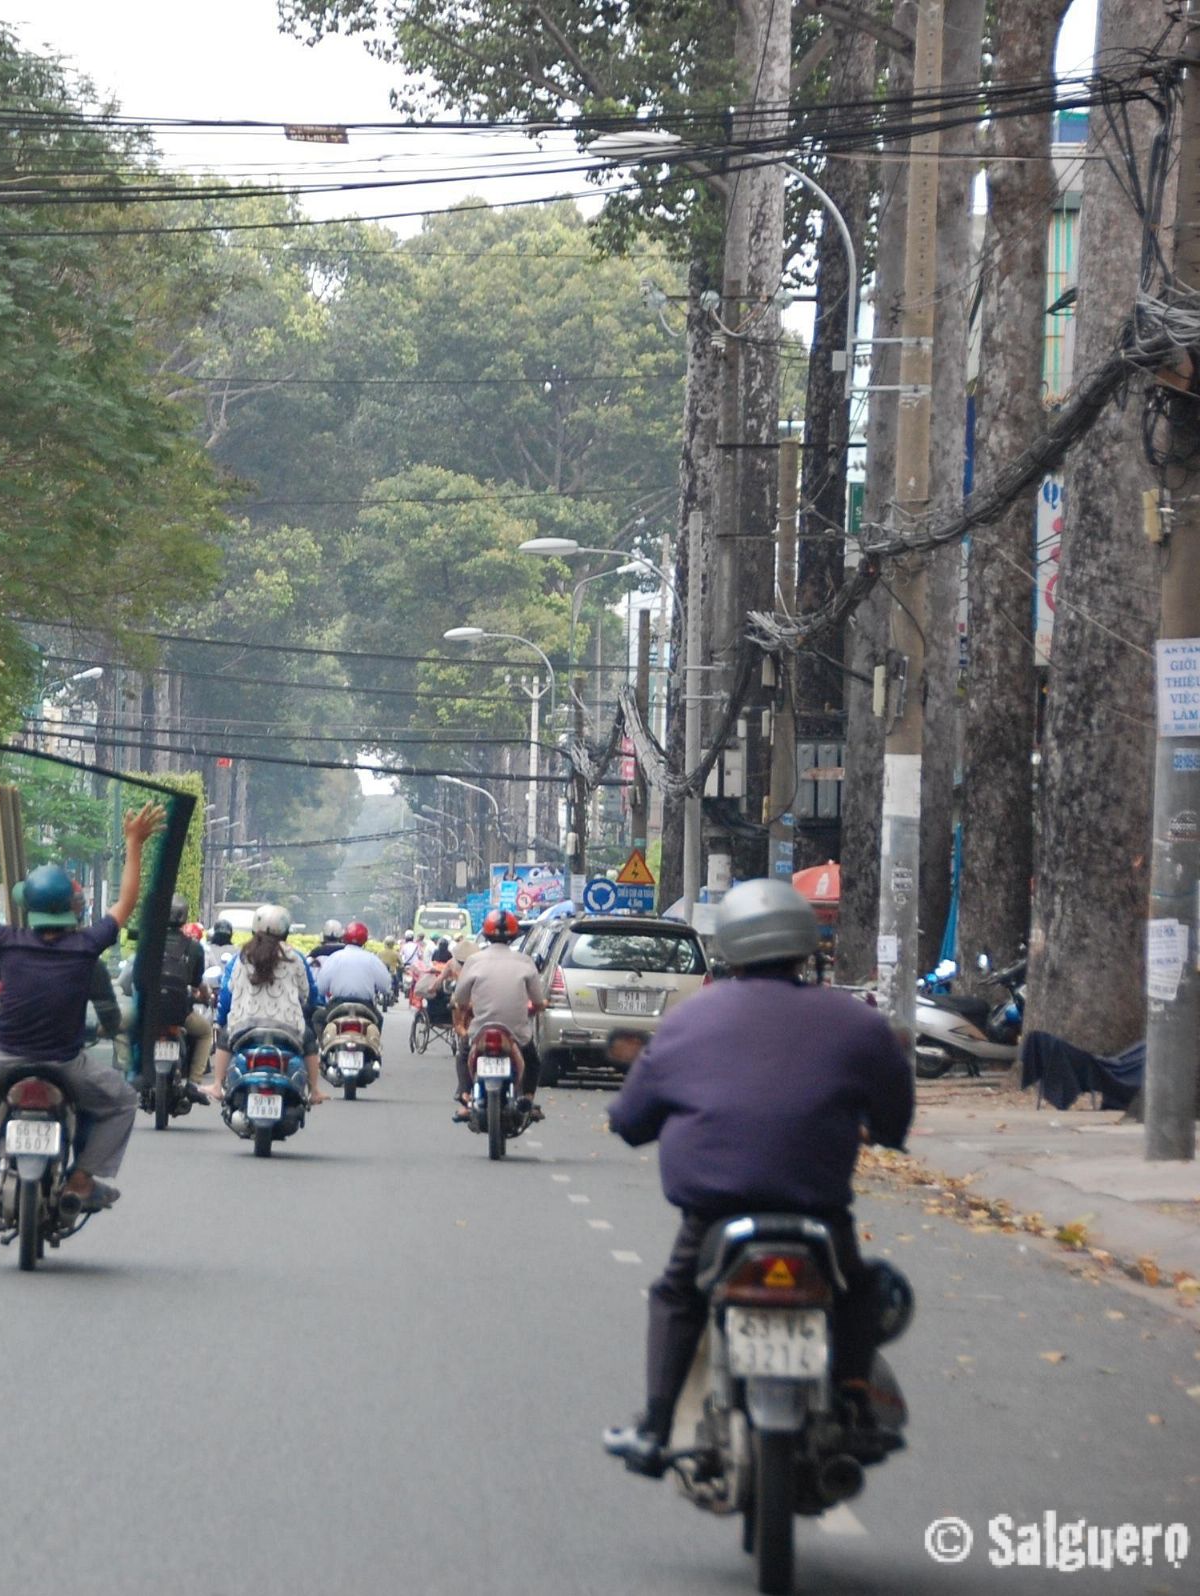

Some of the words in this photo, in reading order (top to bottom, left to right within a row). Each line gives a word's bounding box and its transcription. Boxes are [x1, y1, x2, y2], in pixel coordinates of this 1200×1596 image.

[1170, 658, 1197, 671] GIỚI
[1173, 708, 1199, 721] LÀM
[16, 1137, 50, 1151] 5607
